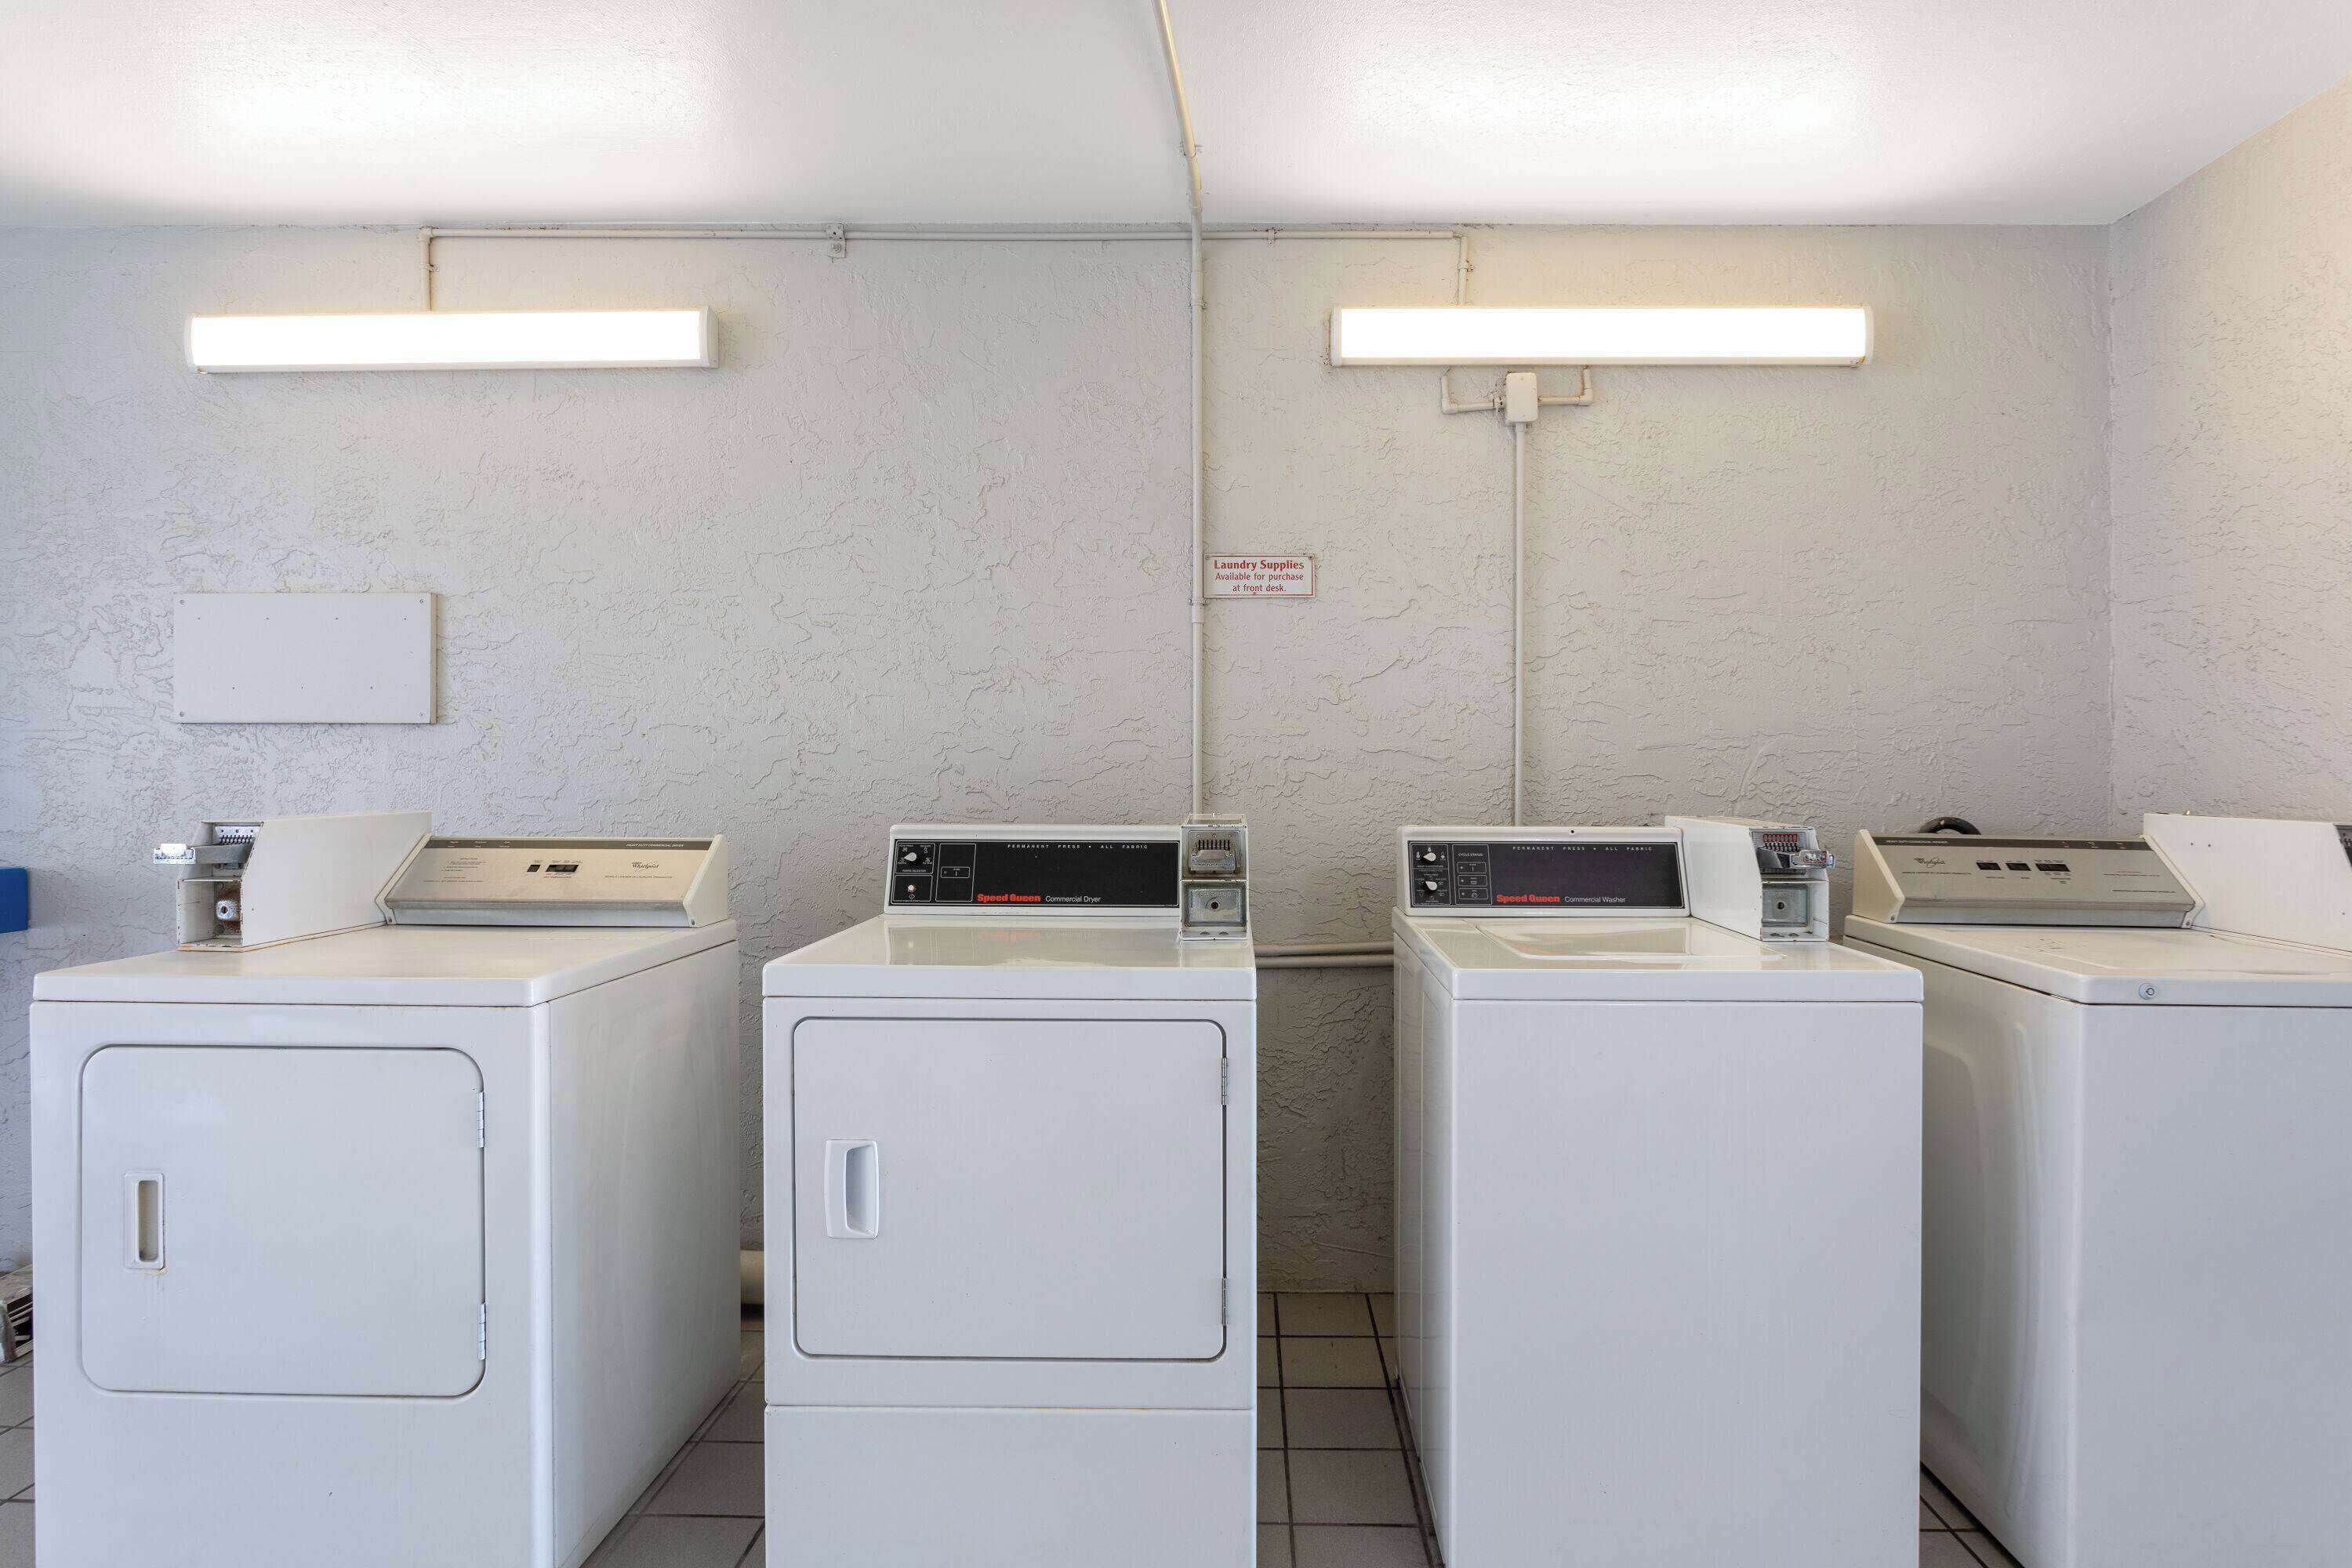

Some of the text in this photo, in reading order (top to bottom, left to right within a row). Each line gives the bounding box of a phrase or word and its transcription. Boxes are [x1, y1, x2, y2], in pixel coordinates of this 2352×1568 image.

[1214, 560, 1305, 571] Laundry Supplies
[1215, 572, 1304, 582] Available for purchase
[1243, 583, 1263, 592] front
[1265, 583, 1287, 592] desk.
[977, 893, 1008, 903] Speed
[1009, 893, 1041, 902] Queen
[1496, 894, 1527, 903] Speed
[1528, 894, 1561, 902] Queen
